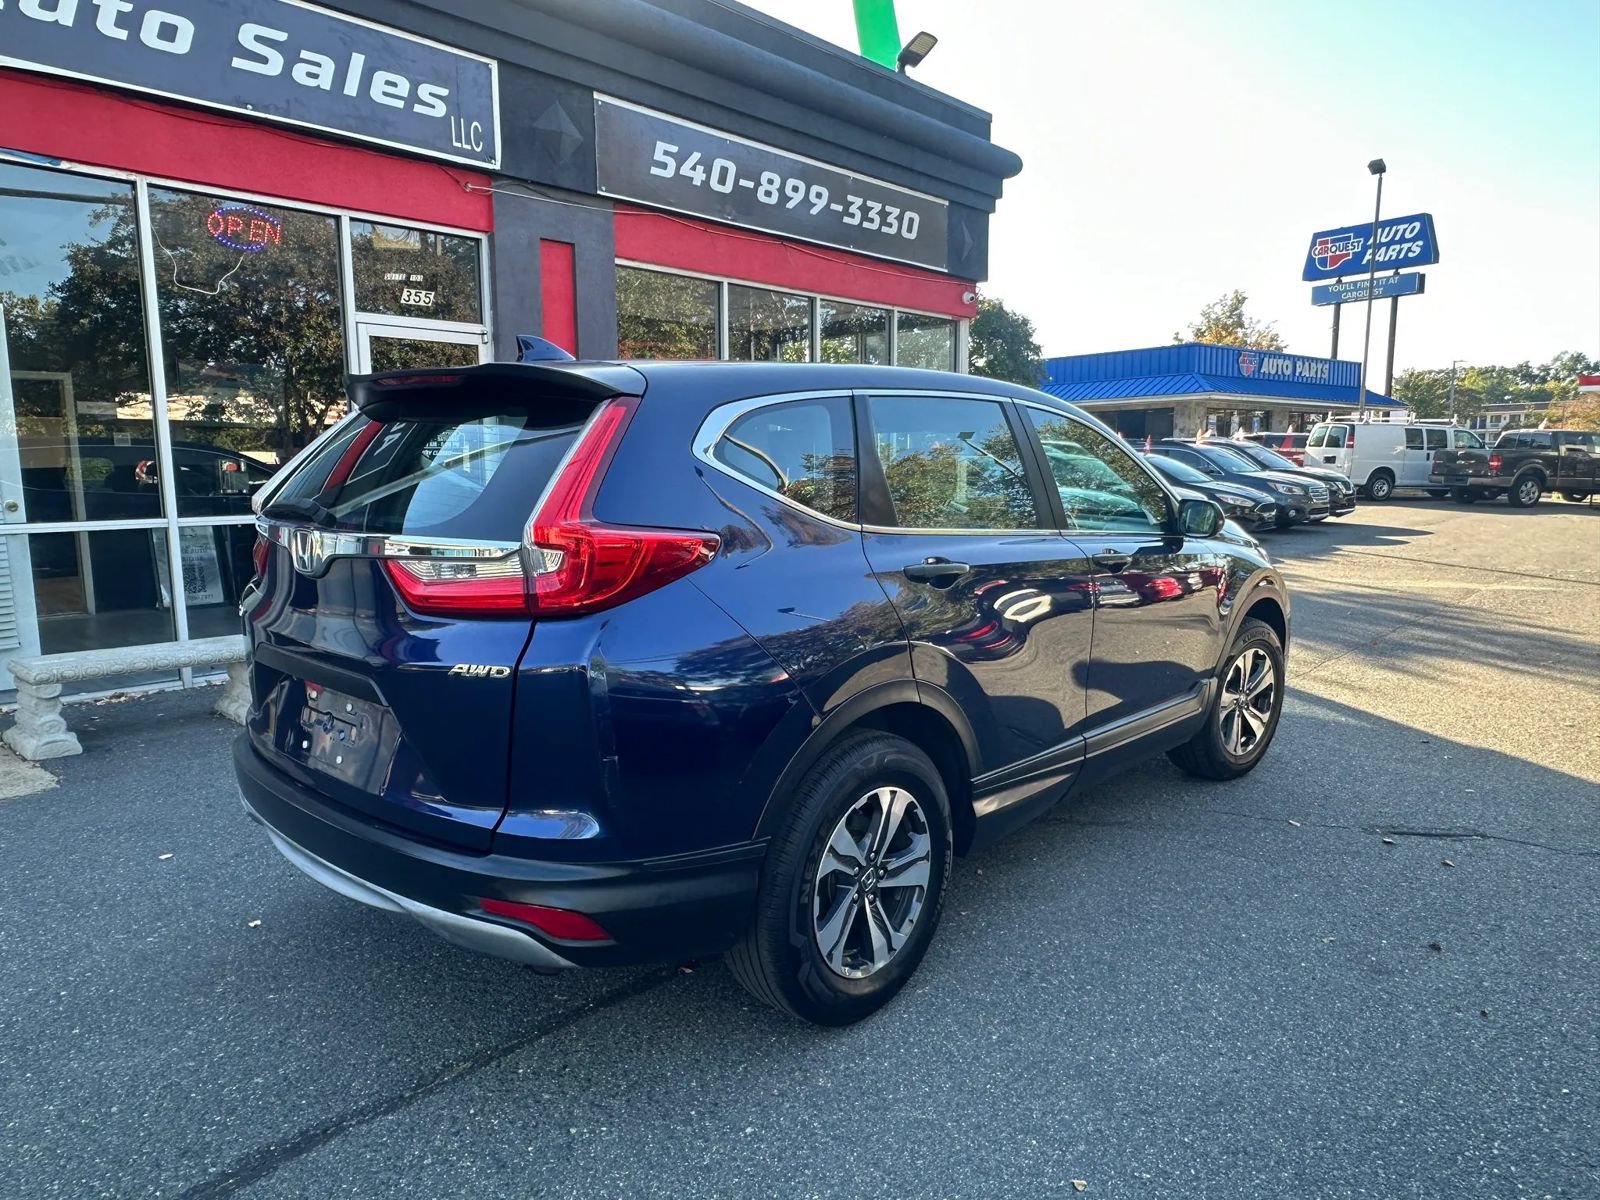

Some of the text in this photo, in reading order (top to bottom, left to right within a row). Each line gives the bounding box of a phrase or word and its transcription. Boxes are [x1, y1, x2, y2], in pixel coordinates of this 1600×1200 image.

[0, 0, 450, 118] uto Sales
[451, 115, 483, 153] LLC
[650, 141, 920, 240] 540-899-3330
[207, 211, 281, 245] OPEN
[1366, 221, 1421, 245] AUTO
[1312, 240, 1362, 257] CARQUEST
[1361, 241, 1424, 264] PARTS
[402, 290, 433, 305] 355
[1341, 288, 1384, 299] CARQUST
[1260, 357, 1293, 376] AUTO
[1295, 360, 1329, 378] PARTS
[447, 663, 511, 678] AWD
